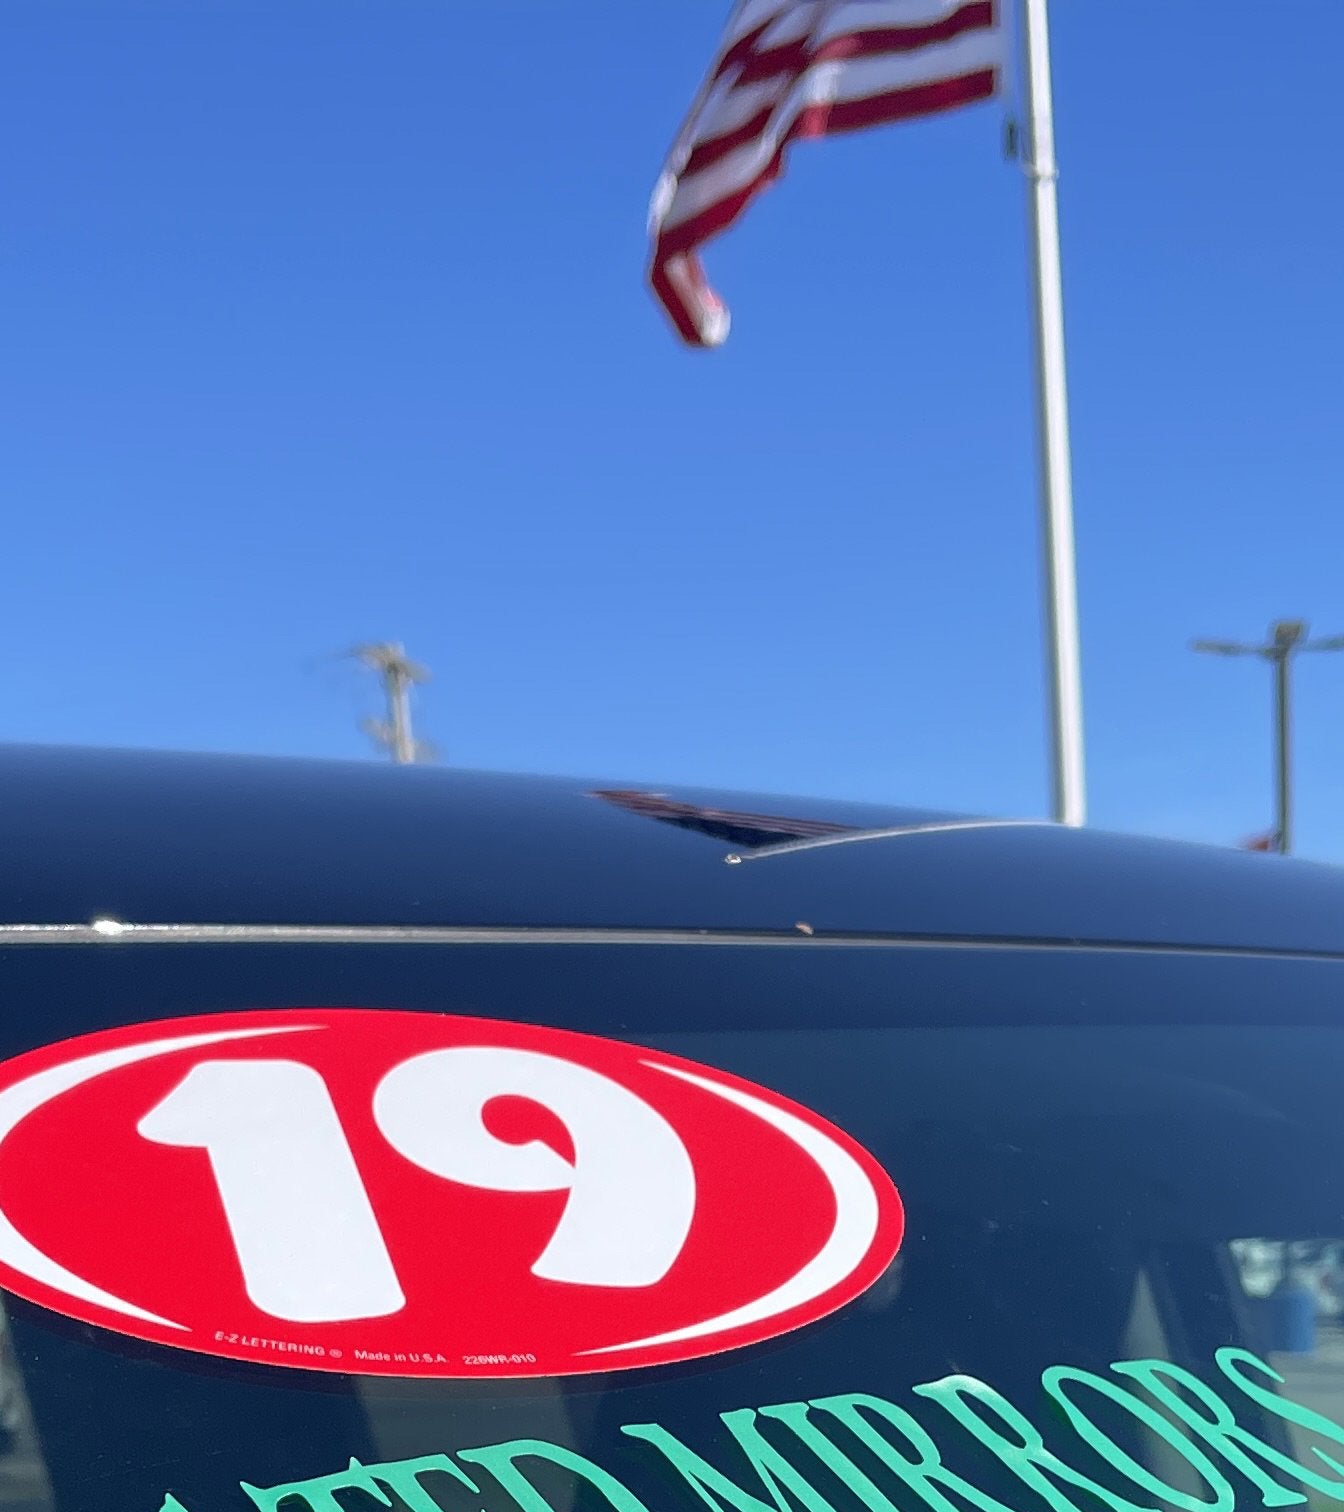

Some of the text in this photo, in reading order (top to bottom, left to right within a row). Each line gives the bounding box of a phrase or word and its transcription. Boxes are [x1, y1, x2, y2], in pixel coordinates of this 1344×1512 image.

[135, 1045, 697, 1323] 19
[214, 1330, 326, 1356] E-Z LETTERING
[354, 1349, 391, 1362] Made
[393, 1352, 407, 1362] in
